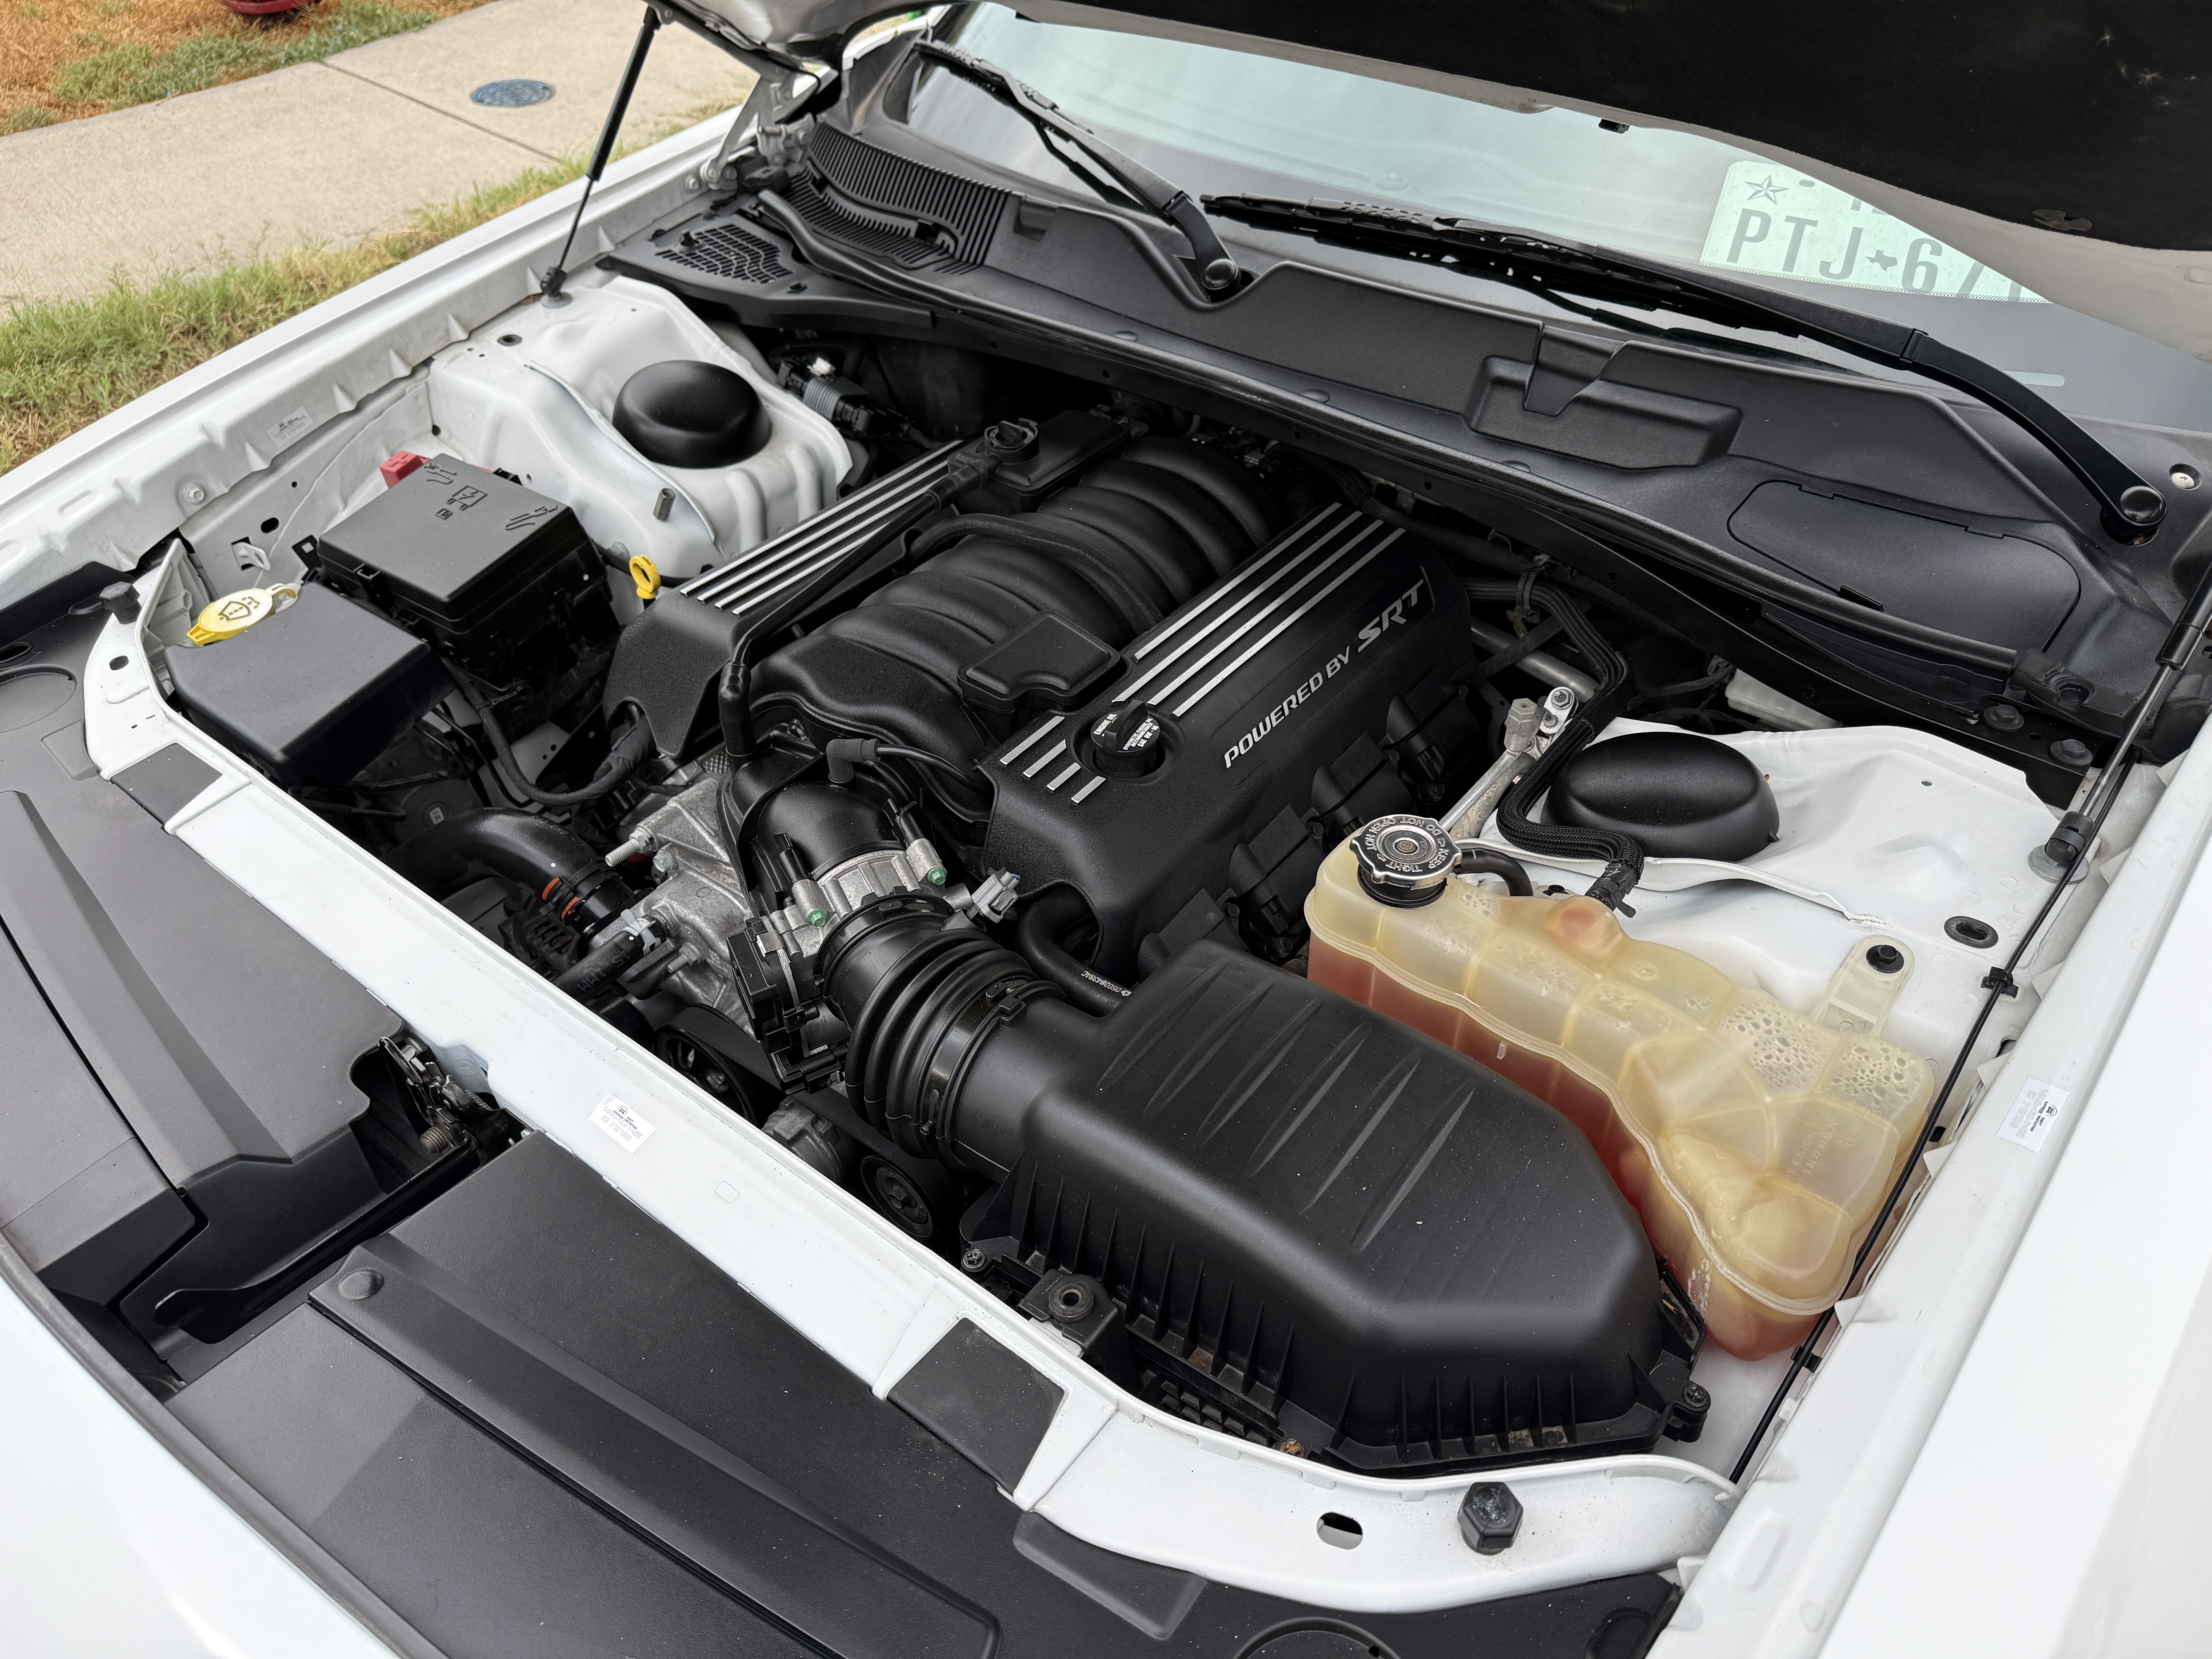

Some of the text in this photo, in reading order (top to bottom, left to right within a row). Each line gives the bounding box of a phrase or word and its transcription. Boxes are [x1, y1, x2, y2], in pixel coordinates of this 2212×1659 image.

[1726, 208, 1864, 280] PTJ
[1224, 579, 1424, 768] POWERED BY SRT
[1093, 719, 1111, 735] ENGINE
[1130, 722, 1153, 747] RECOMMENDED
[1123, 732, 1138, 750] SYNTHETIC
[1137, 738, 1147, 747] SAE
[1365, 817, 1442, 851] DO NOT OPEN HOT
[1386, 848, 1449, 872] KEEP TIGHT
